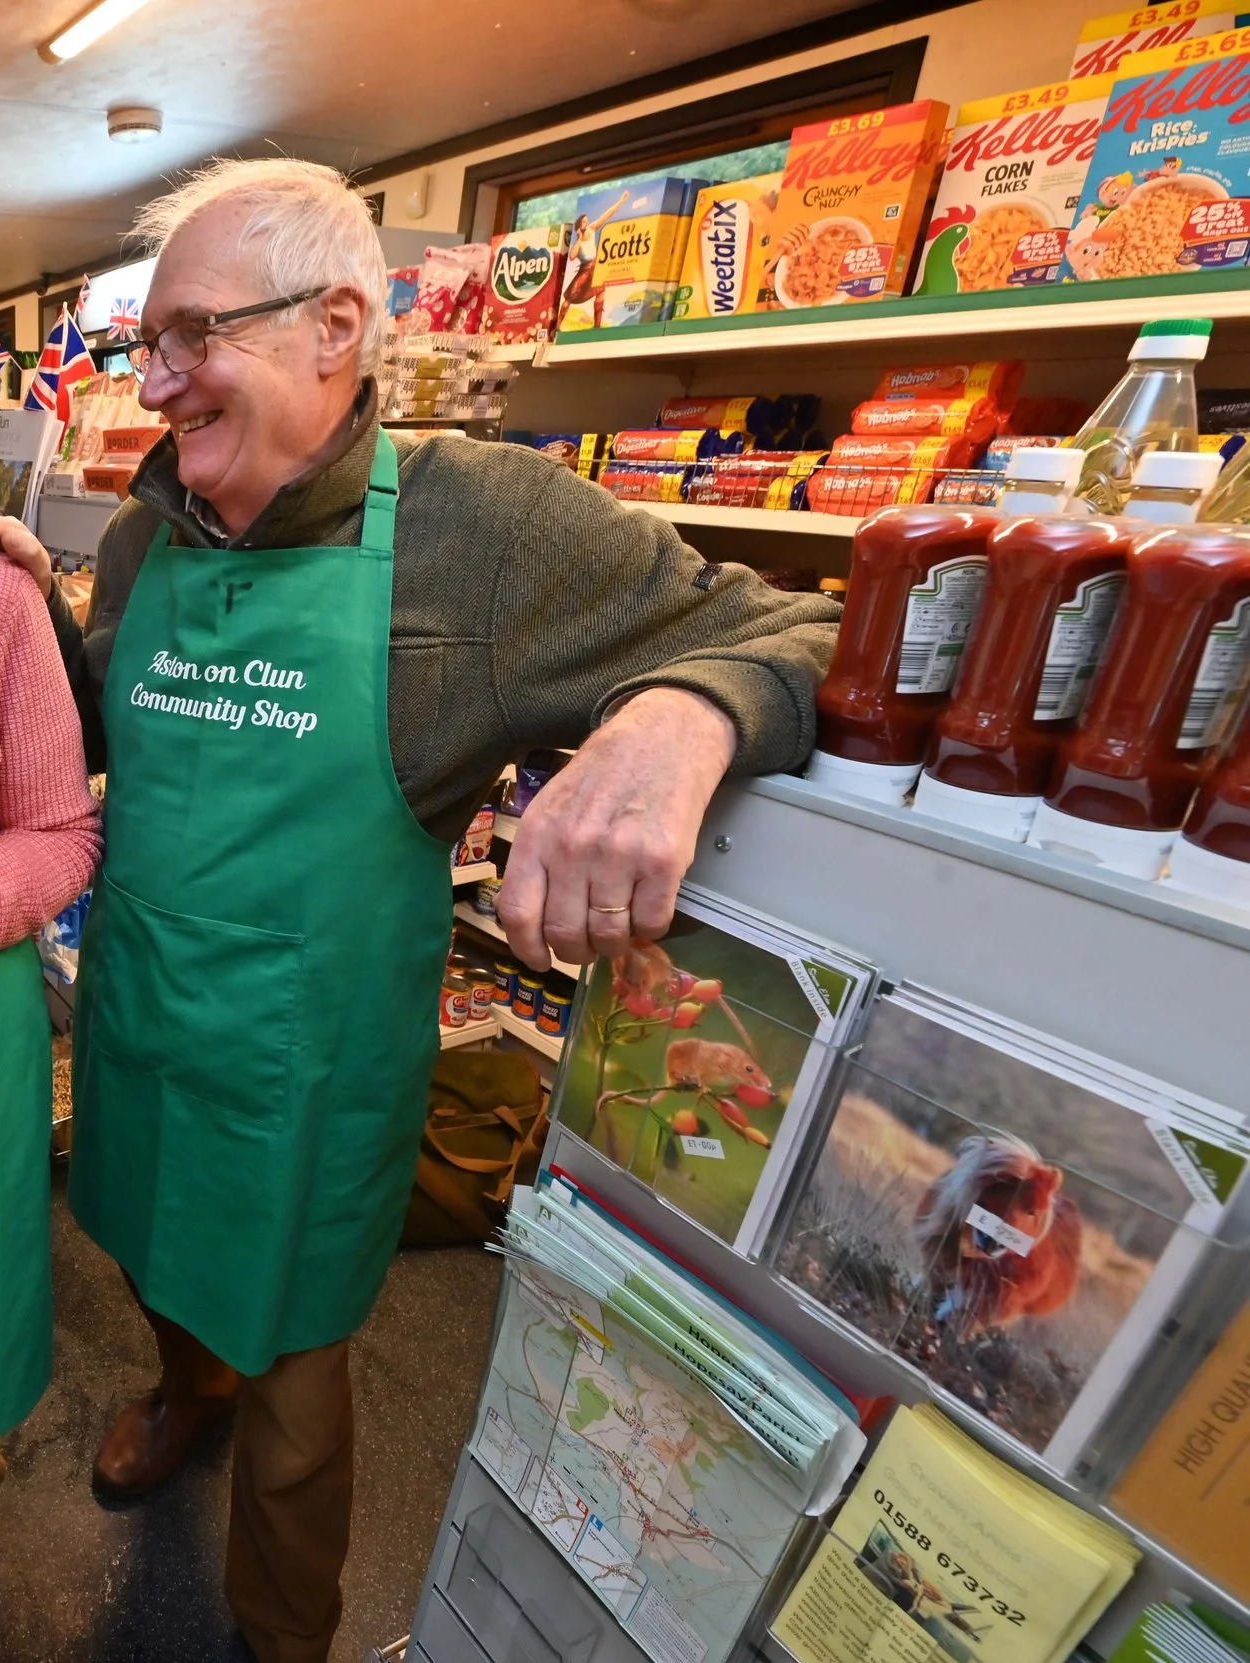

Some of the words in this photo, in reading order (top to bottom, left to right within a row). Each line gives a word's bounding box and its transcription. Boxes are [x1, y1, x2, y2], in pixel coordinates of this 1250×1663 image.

[1128, 0, 1200, 27] £3.49
[1002, 85, 1070, 113] £3.49
[827, 111, 886, 137] £3.69
[1129, 131, 1210, 157] Krispies
[985, 160, 1035, 184] CORN
[803, 184, 862, 208] CRUNCHY
[980, 178, 1029, 198] FLAKES
[819, 197, 845, 210] NUT
[1189, 201, 1242, 224] 25%
[1196, 214, 1245, 235] great
[1202, 227, 1229, 237] days
[598, 231, 651, 264] Scott's
[1017, 231, 1058, 251] 25%
[714, 200, 737, 313] Weetabix
[844, 245, 879, 262] 25%
[1022, 245, 1062, 260] great
[493, 251, 550, 283] Alpen
[848, 259, 882, 271] great
[891, 369, 941, 388] Hobnobs
[663, 404, 707, 421] Digestives
[868, 407, 919, 426] Hobnobs
[107, 436, 139, 450] BORDER
[617, 438, 658, 455] Digestives
[840, 442, 890, 458] Hobnobs
[86, 475, 114, 489] BORDER
[823, 476, 872, 491] Hobnobs
[148, 651, 201, 681] Aston
[204, 664, 240, 684] on
[244, 660, 306, 690] Clun
[131, 682, 247, 730] Community
[251, 700, 318, 739] Shop
[789, 958, 811, 987] Blank
[805, 986, 831, 1020] inside
[670, 1341, 747, 1404] Hopesay
[1172, 1420, 1226, 1475] HIGH
[873, 1488, 932, 1551] 01588
[937, 1552, 1026, 1627] 673732
